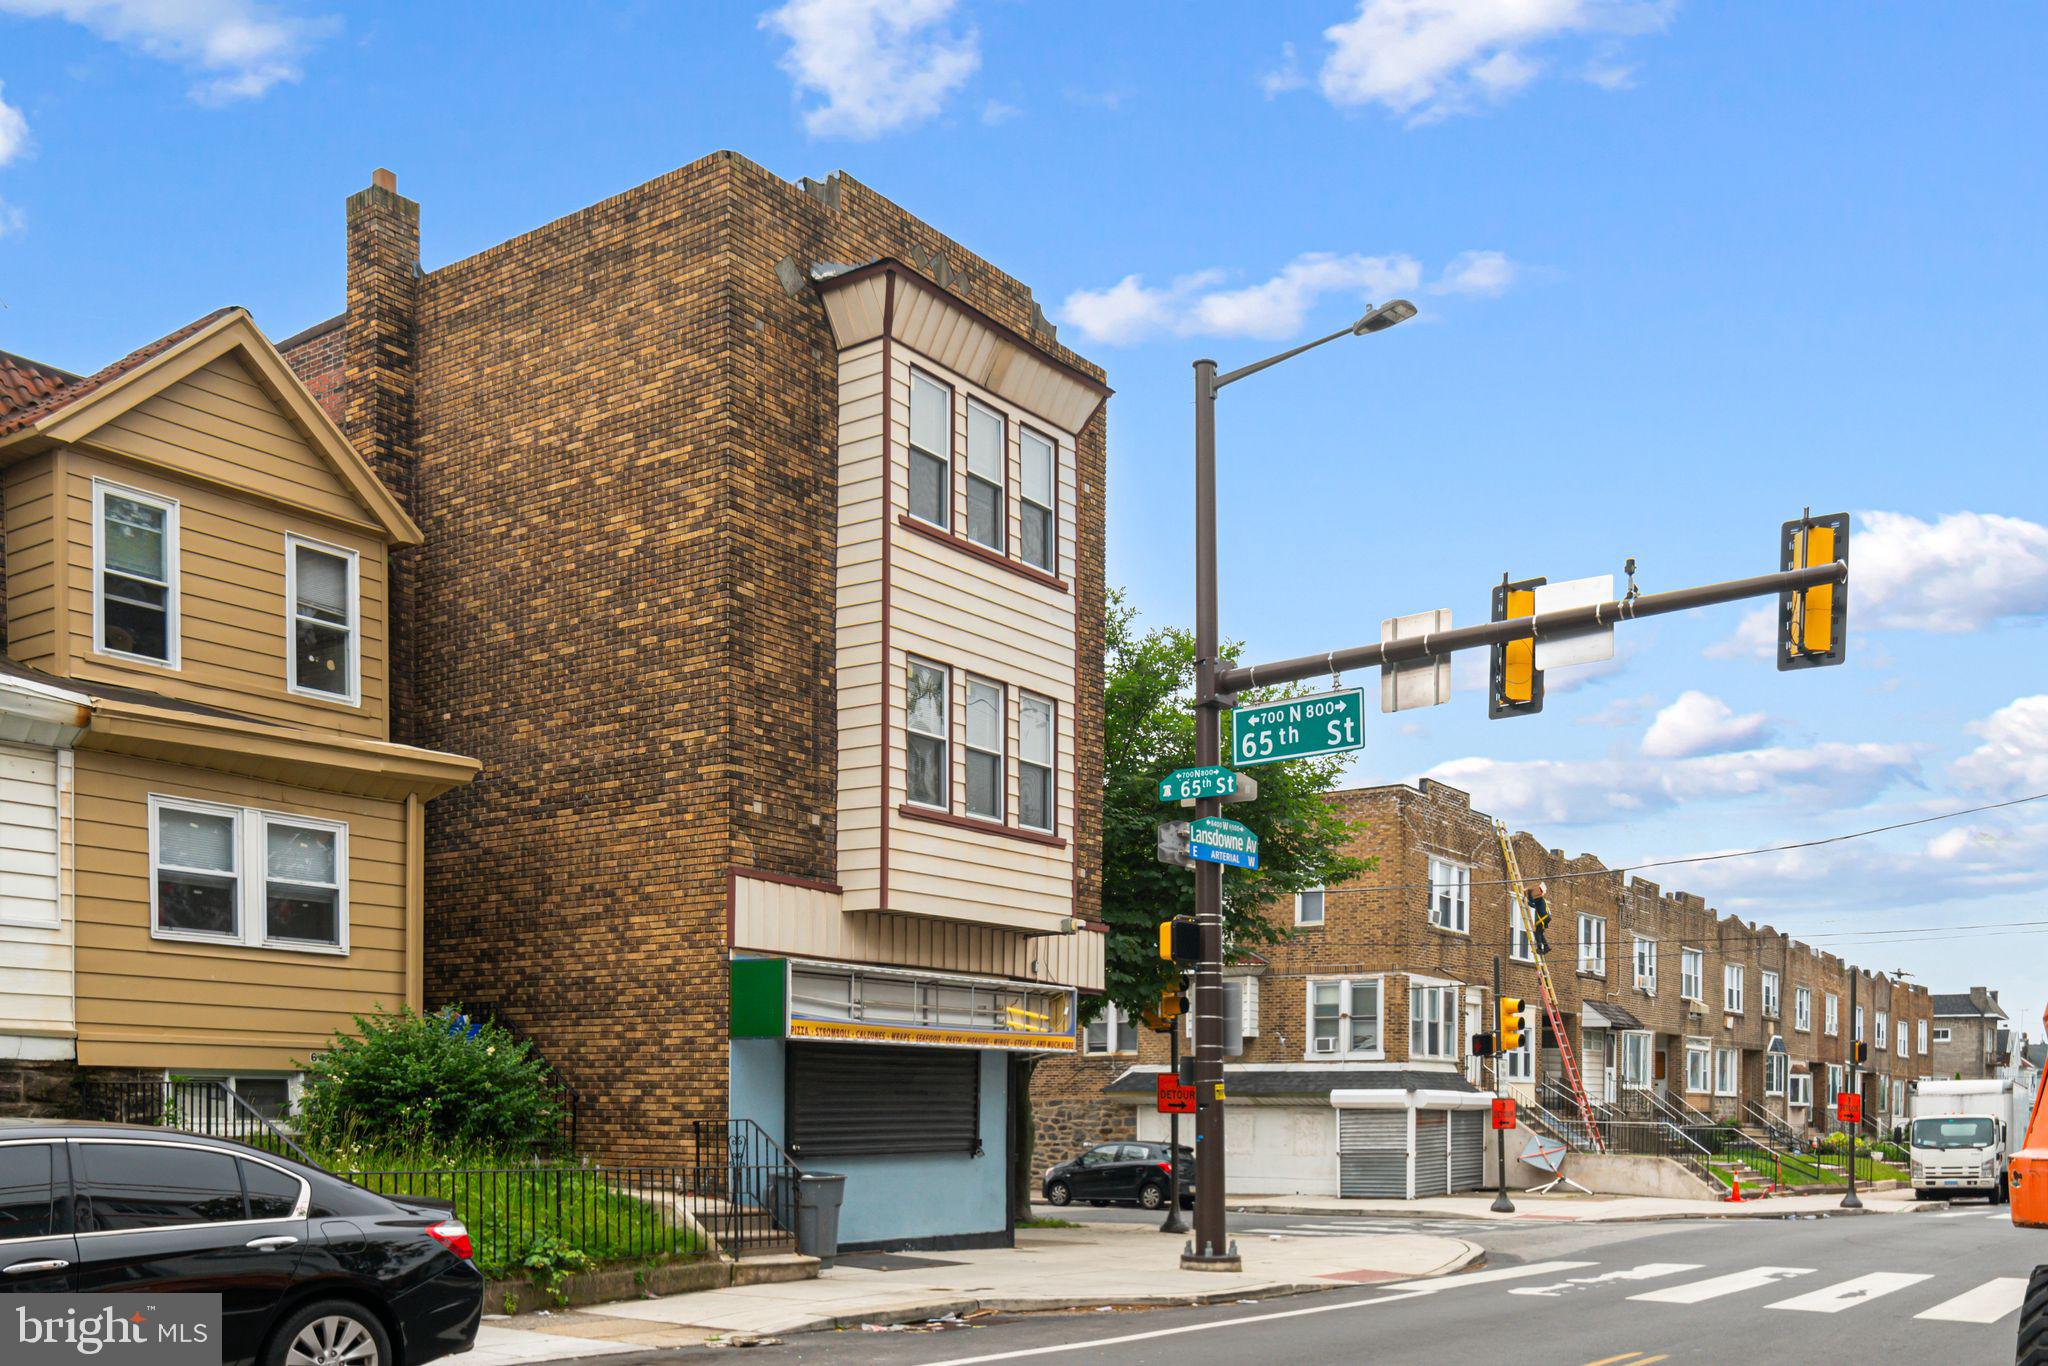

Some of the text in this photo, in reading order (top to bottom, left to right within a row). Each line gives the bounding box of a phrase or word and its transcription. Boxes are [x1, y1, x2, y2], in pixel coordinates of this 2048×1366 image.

[1260, 701, 1334, 725] 700 N 800
[1327, 717, 1355, 746] St
[1182, 771, 1195, 779] 700
[1194, 769, 1200, 778] N
[1215, 775, 1235, 794] St
[1222, 821, 1229, 831] W
[1190, 825, 1257, 854] Lansdowne Av
[1192, 845, 1255, 867] E ARTERIAL W
[790, 1025, 809, 1036] PIZZA
[815, 1026, 850, 1038] STROMBOLI
[855, 1029, 886, 1040] CALZONES
[891, 1031, 910, 1041] WRAPS
[1160, 1089, 1196, 1100] DETOUR
